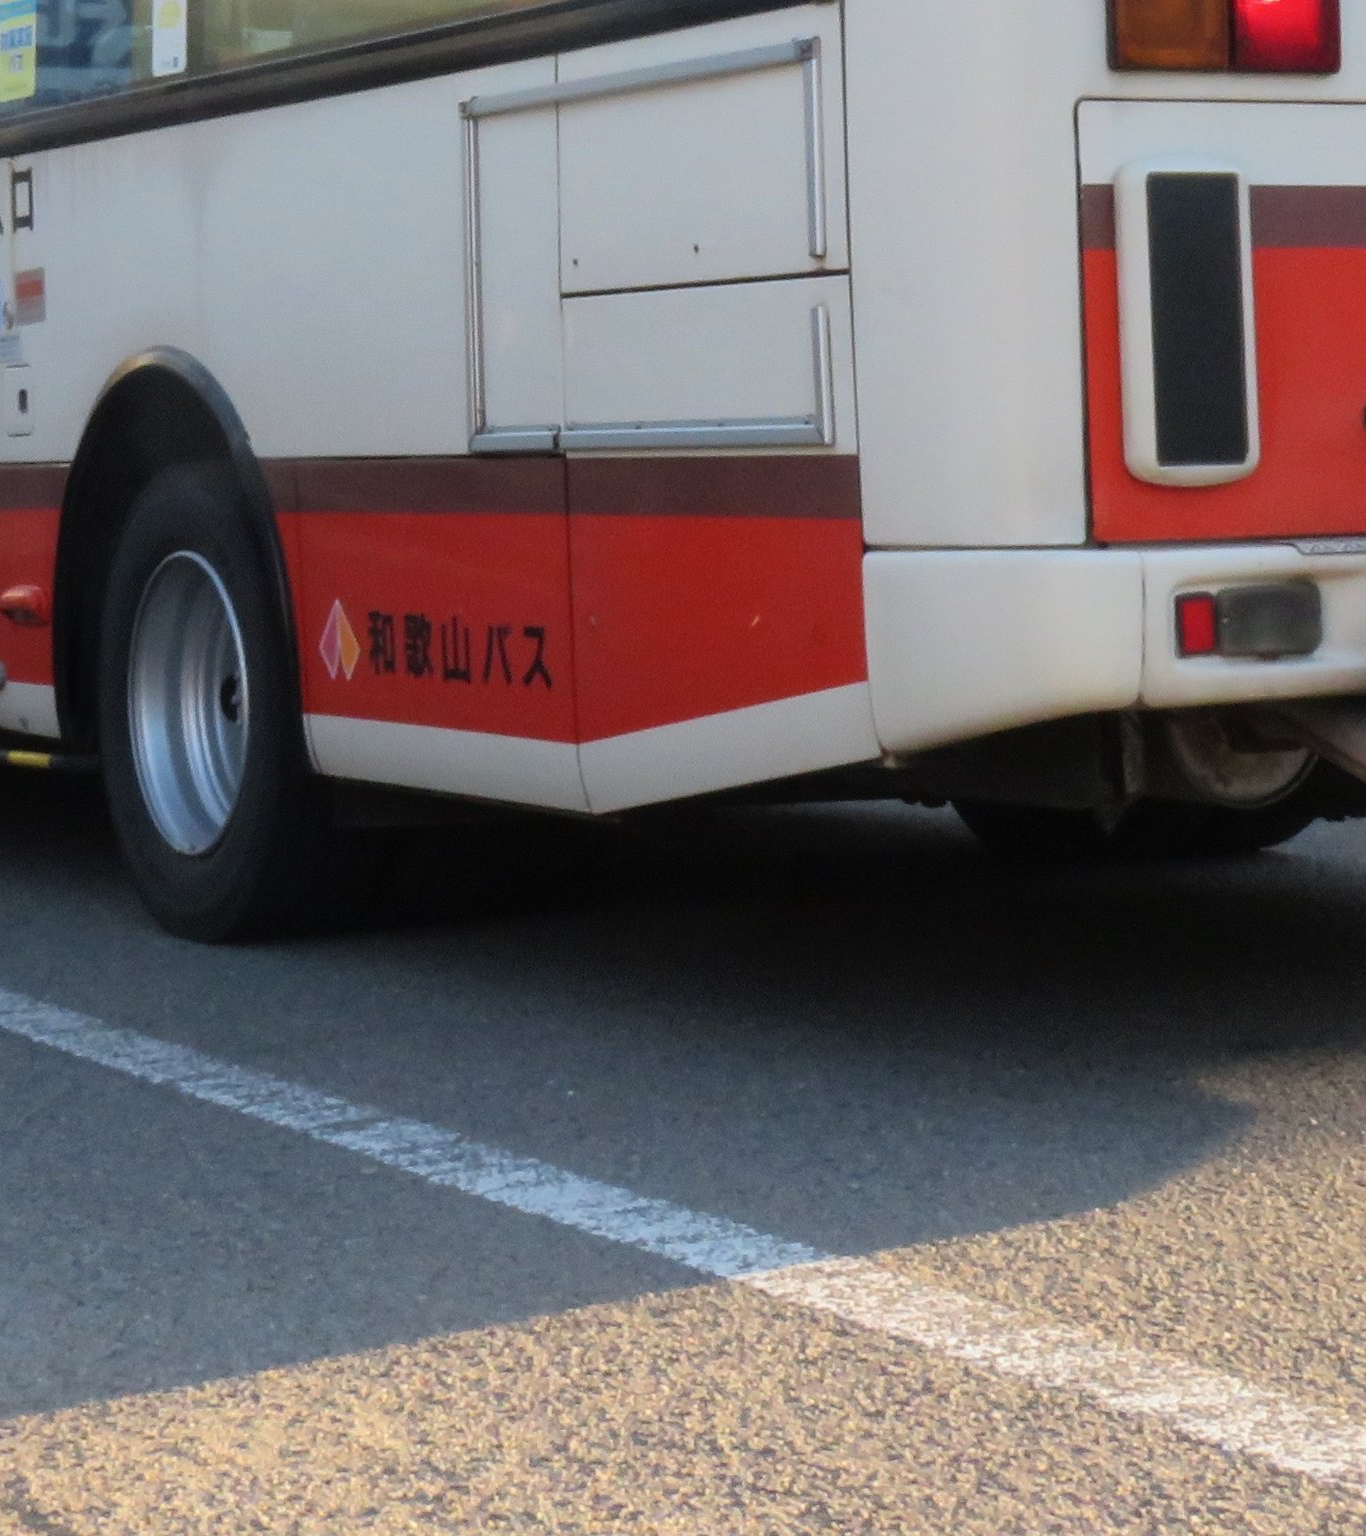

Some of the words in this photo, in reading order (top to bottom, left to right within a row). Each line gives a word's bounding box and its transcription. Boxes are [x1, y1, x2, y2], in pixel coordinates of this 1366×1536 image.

[368, 610, 553, 689] 和歌山バス
